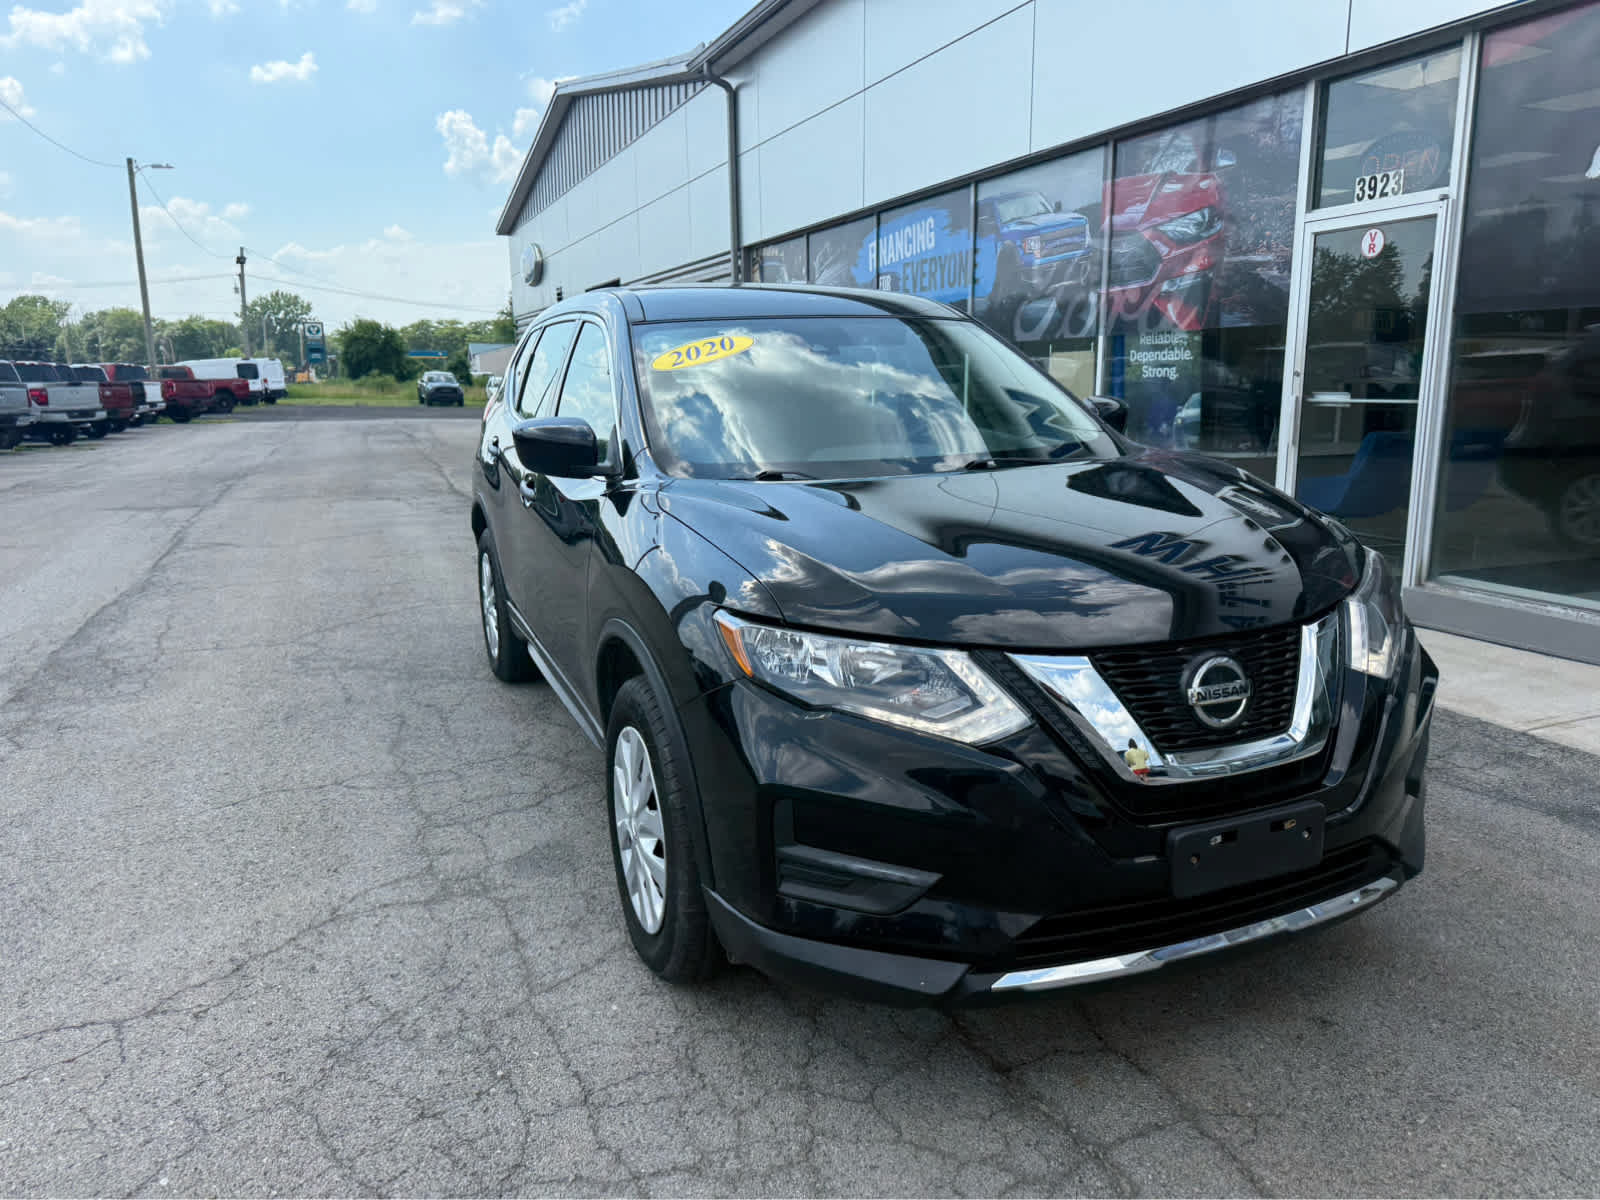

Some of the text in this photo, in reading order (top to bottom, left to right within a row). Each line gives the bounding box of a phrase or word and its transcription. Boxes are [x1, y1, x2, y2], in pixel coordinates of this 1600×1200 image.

[1356, 171, 1402, 202] 3923
[670, 336, 734, 367] 2020
[1129, 346, 1193, 364] Dependable.
[1142, 364, 1179, 380] Strong.
[1196, 684, 1249, 702] NISSAN
